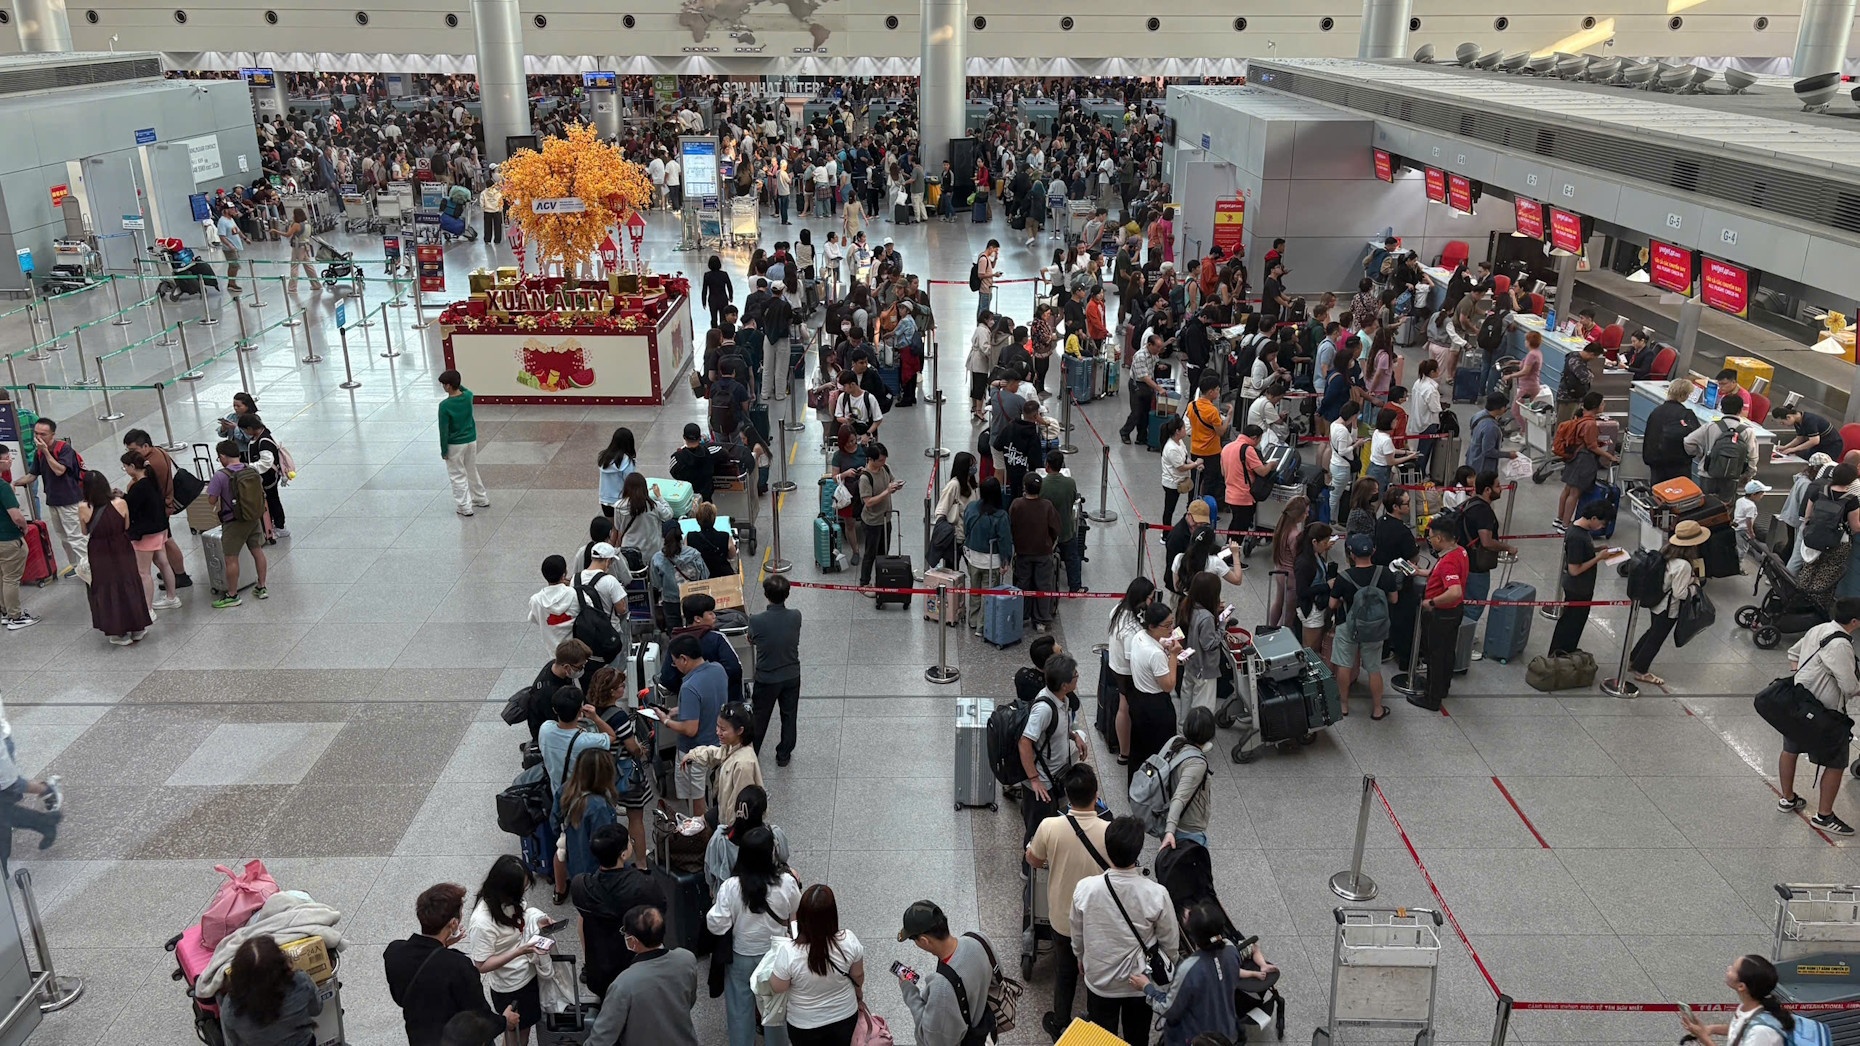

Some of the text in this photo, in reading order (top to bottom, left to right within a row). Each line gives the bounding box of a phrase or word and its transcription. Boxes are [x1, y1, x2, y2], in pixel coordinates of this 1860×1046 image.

[536, 201, 557, 210] ACV
[1668, 215, 1680, 227] G-5
[1723, 230, 1736, 242] G-4
[485, 284, 548, 311] XUÂN
